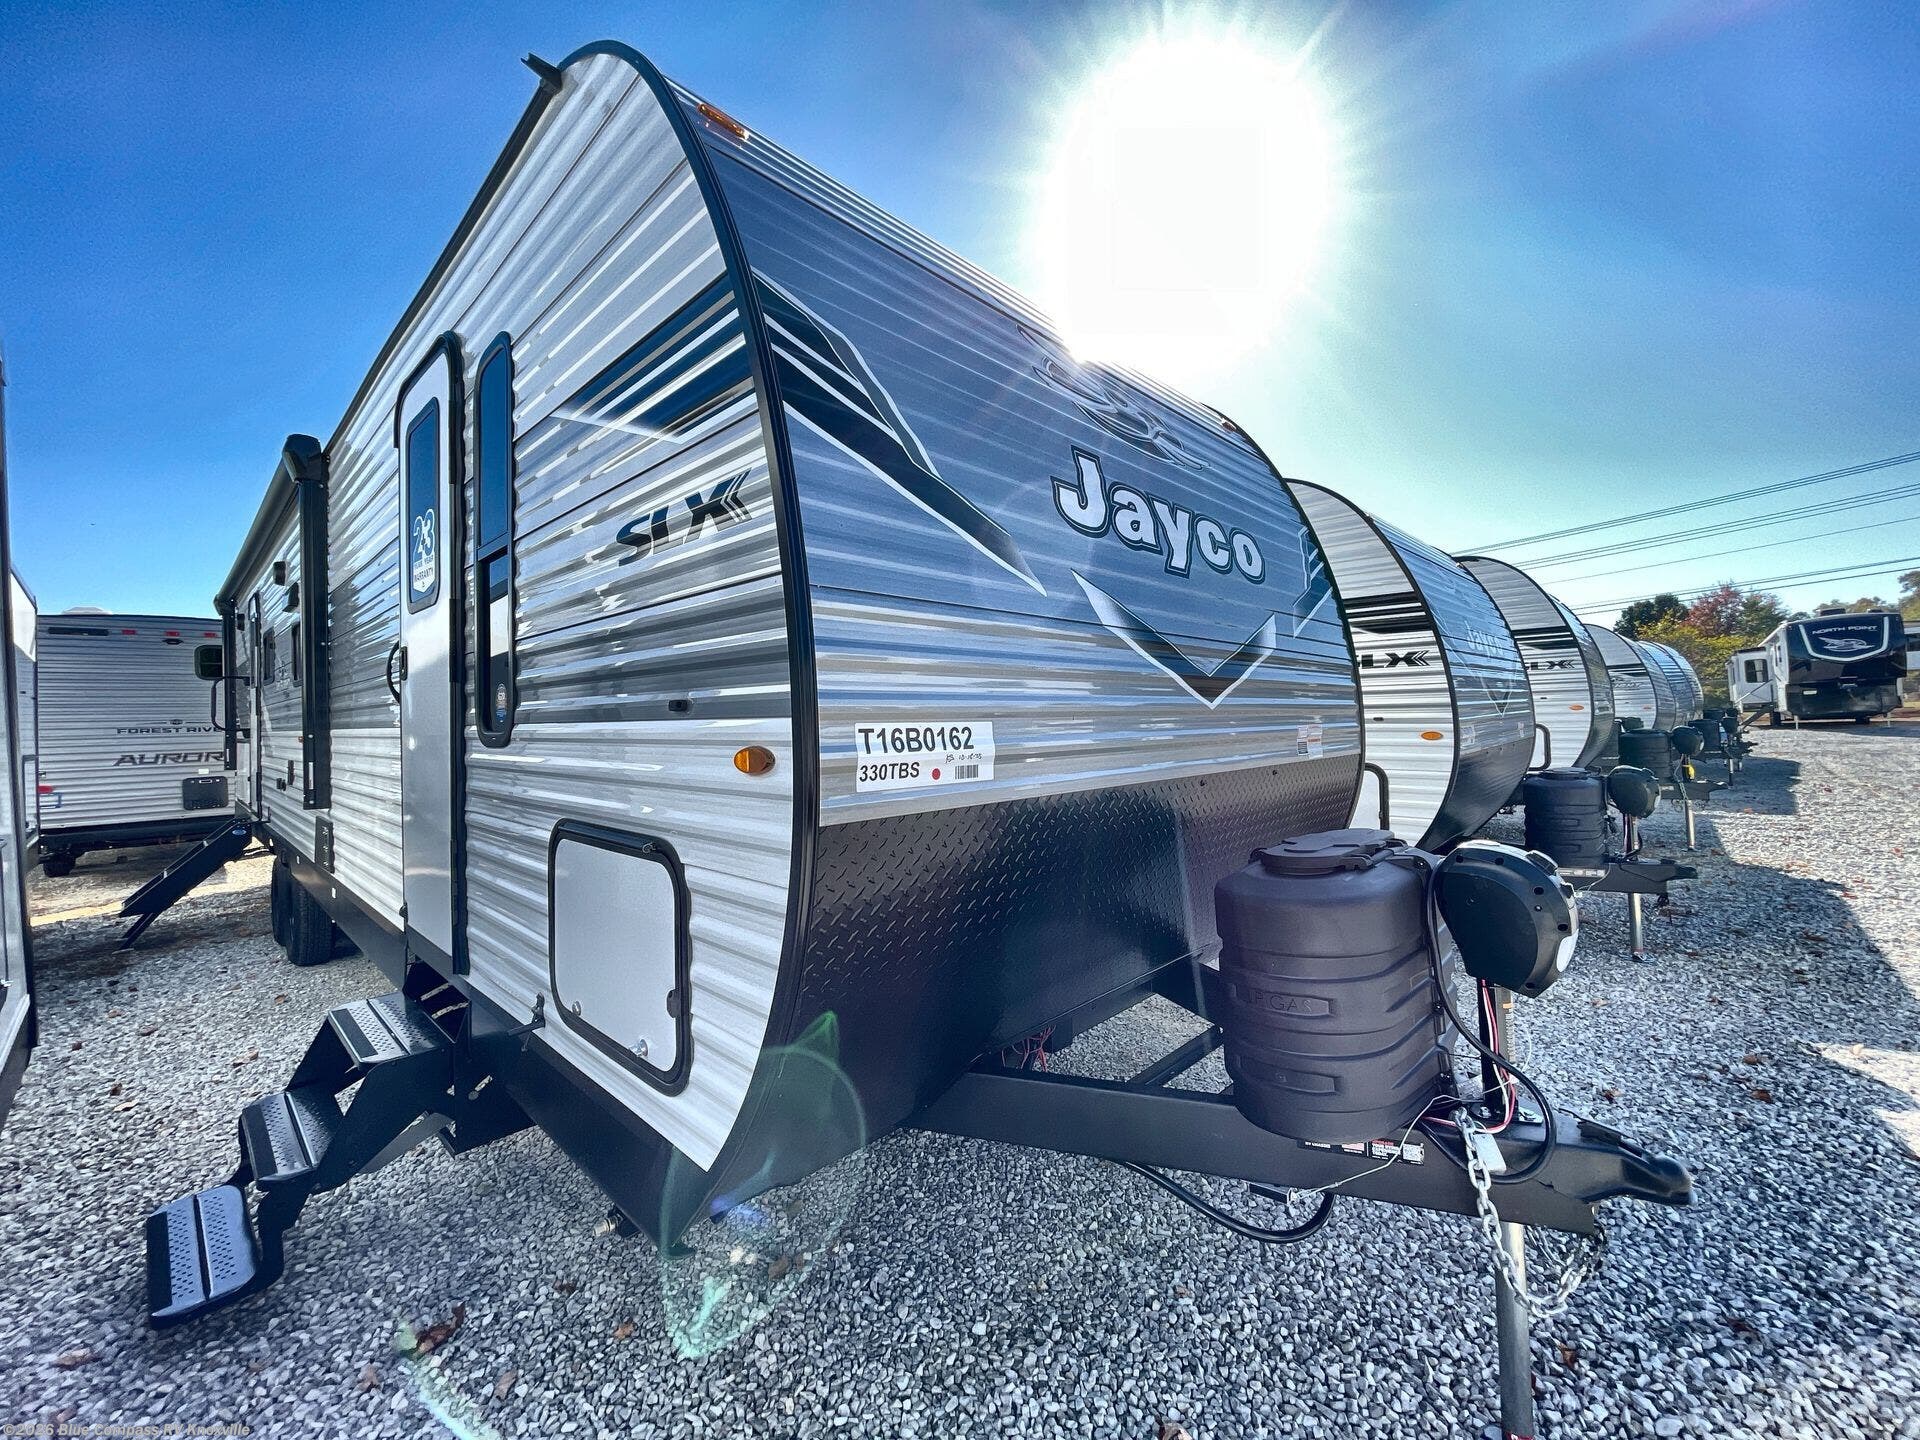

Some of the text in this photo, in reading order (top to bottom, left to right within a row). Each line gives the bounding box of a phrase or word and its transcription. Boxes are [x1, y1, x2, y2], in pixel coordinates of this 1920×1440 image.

[616, 467, 752, 567] SLX
[1050, 445, 1266, 584] Jayco
[1812, 626, 1845, 635] NORTH
[1356, 650, 1430, 668] LX
[858, 726, 974, 754] T16B0162
[112, 752, 224, 766] AUROR
[859, 762, 920, 782] 330TBS
